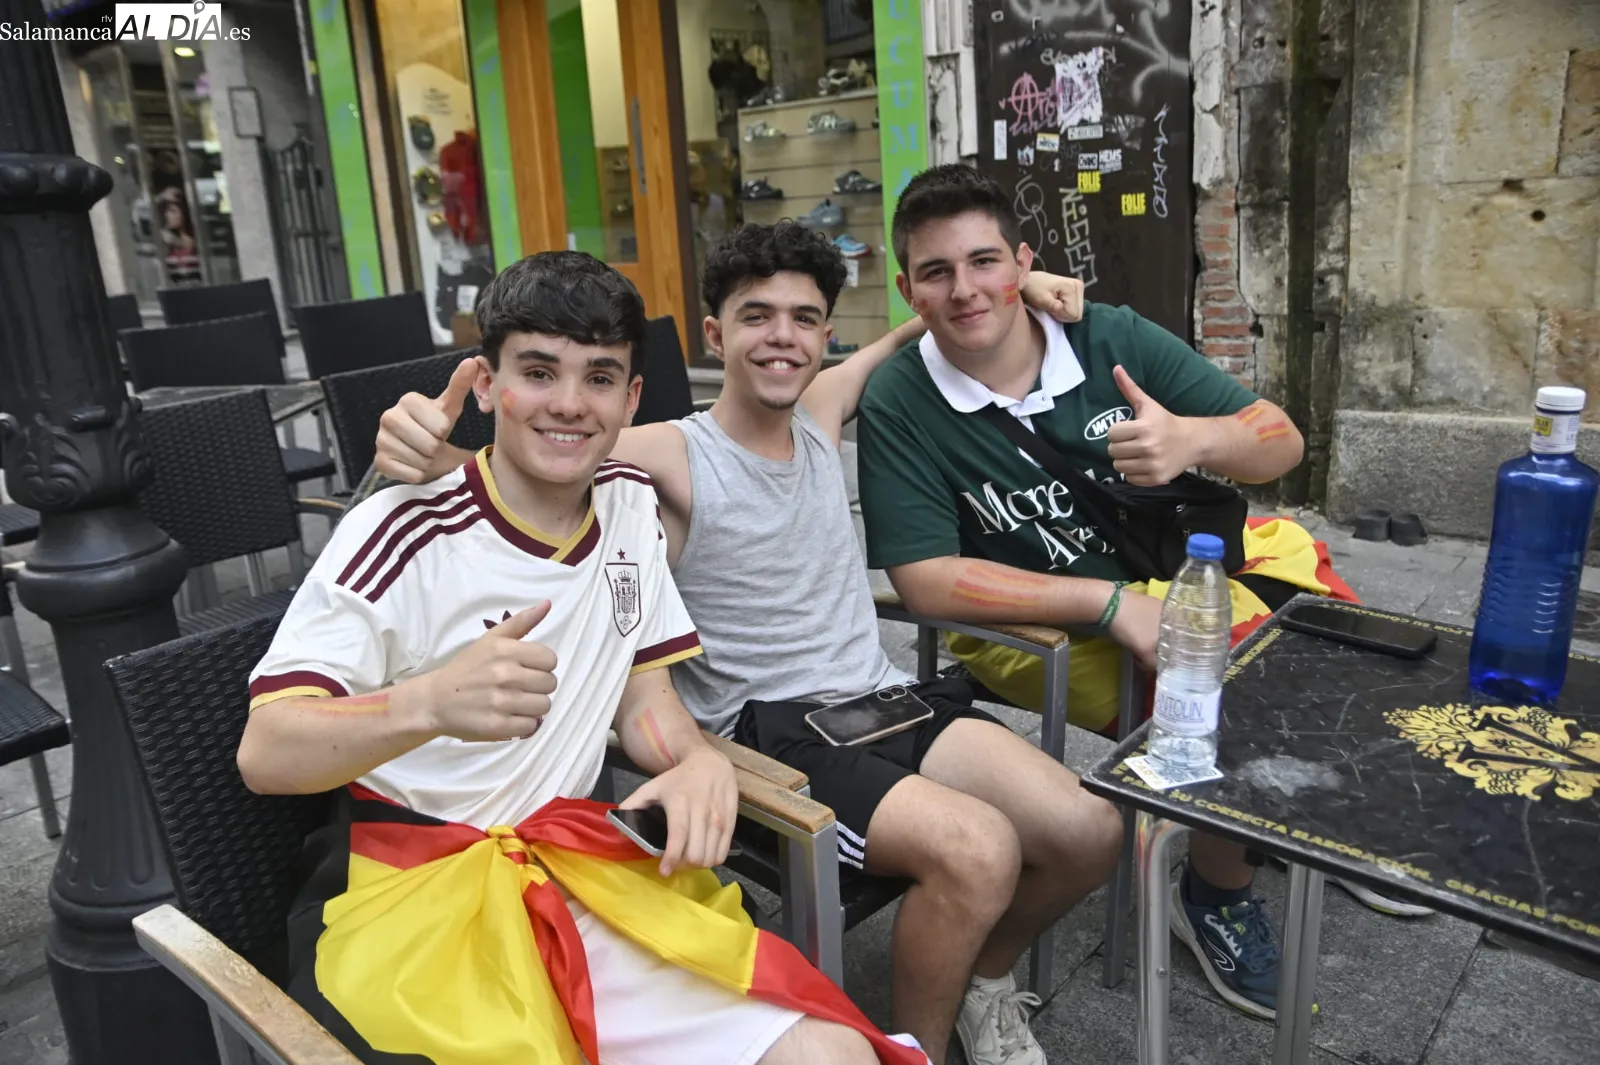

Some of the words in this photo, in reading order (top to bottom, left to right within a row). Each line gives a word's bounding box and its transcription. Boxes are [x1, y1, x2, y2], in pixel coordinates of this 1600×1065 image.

[960, 480, 1074, 534] More
[1194, 799, 1287, 835] CORRECTA
[1445, 879, 1547, 919] GRACIAS
